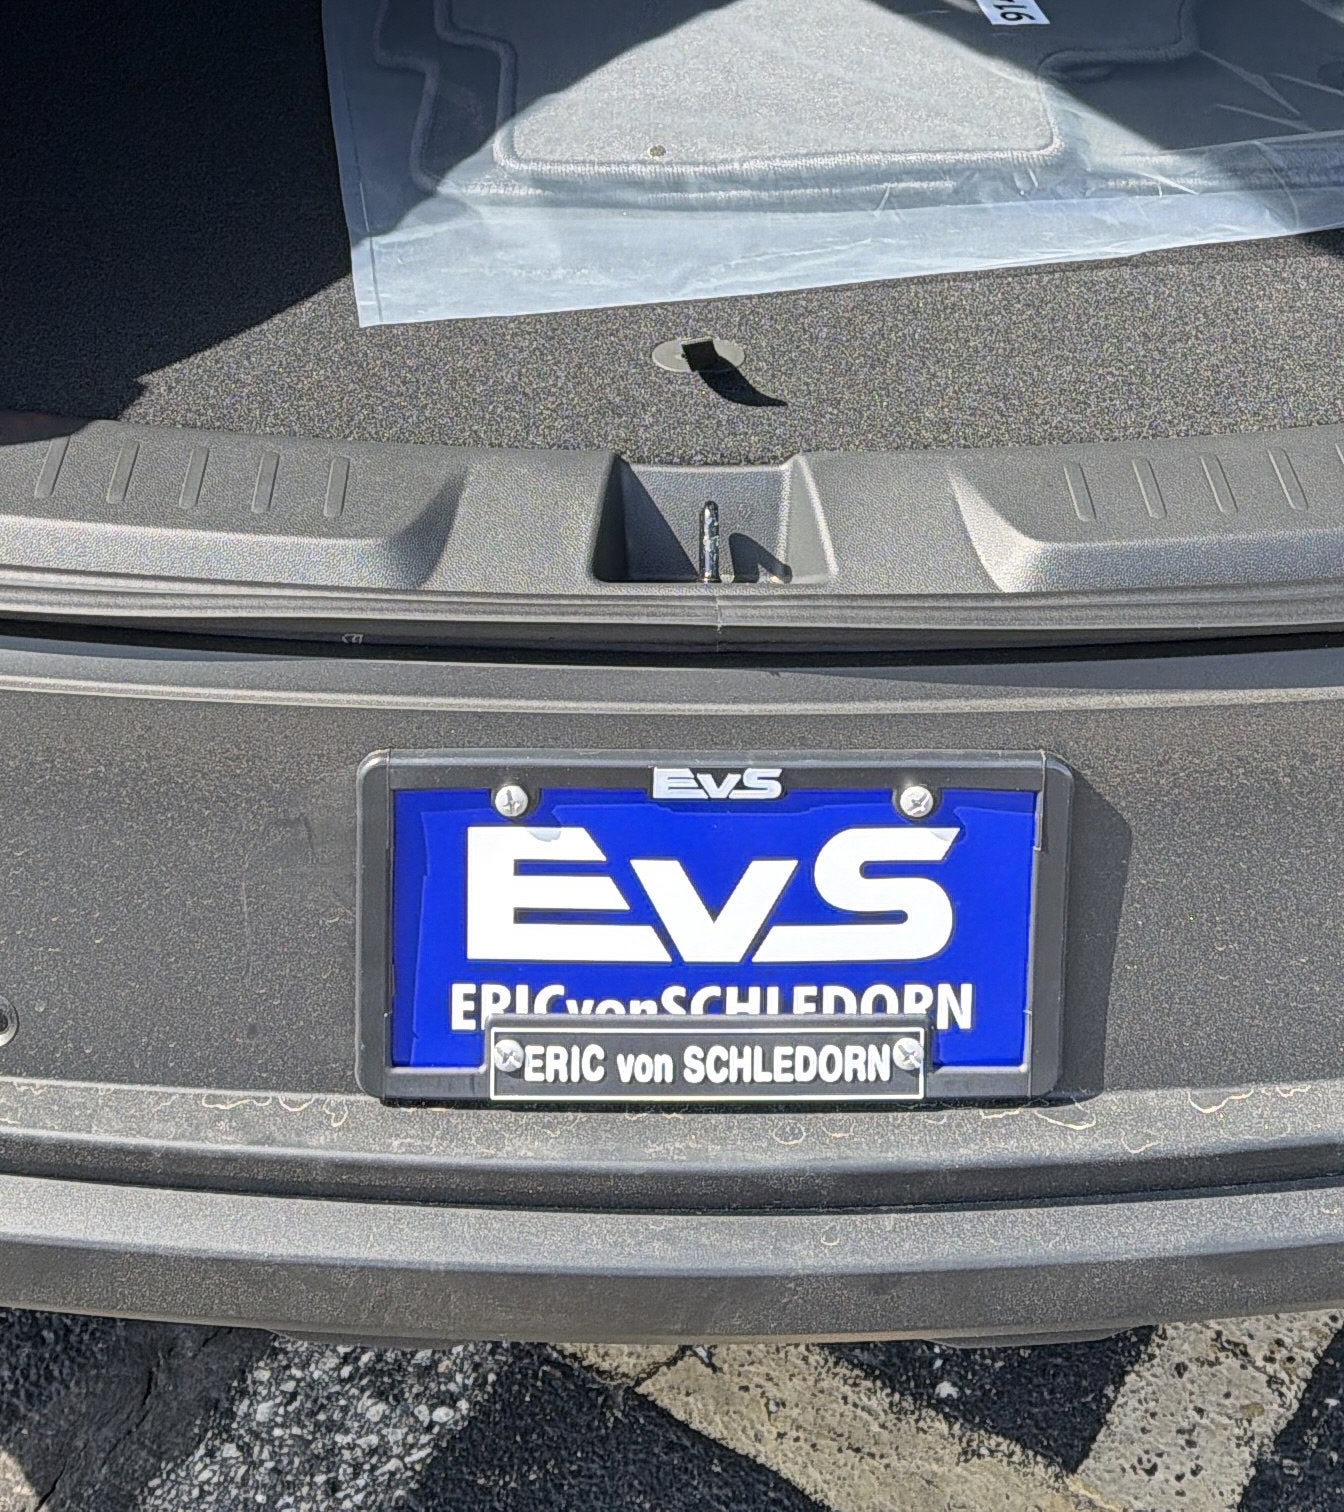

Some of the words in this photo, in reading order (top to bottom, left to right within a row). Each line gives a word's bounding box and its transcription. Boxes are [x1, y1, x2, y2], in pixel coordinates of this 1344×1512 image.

[524, 1044, 605, 1083] ERIC
[616, 1053, 674, 1084] von
[683, 1043, 891, 1084] SCHLEDORN
